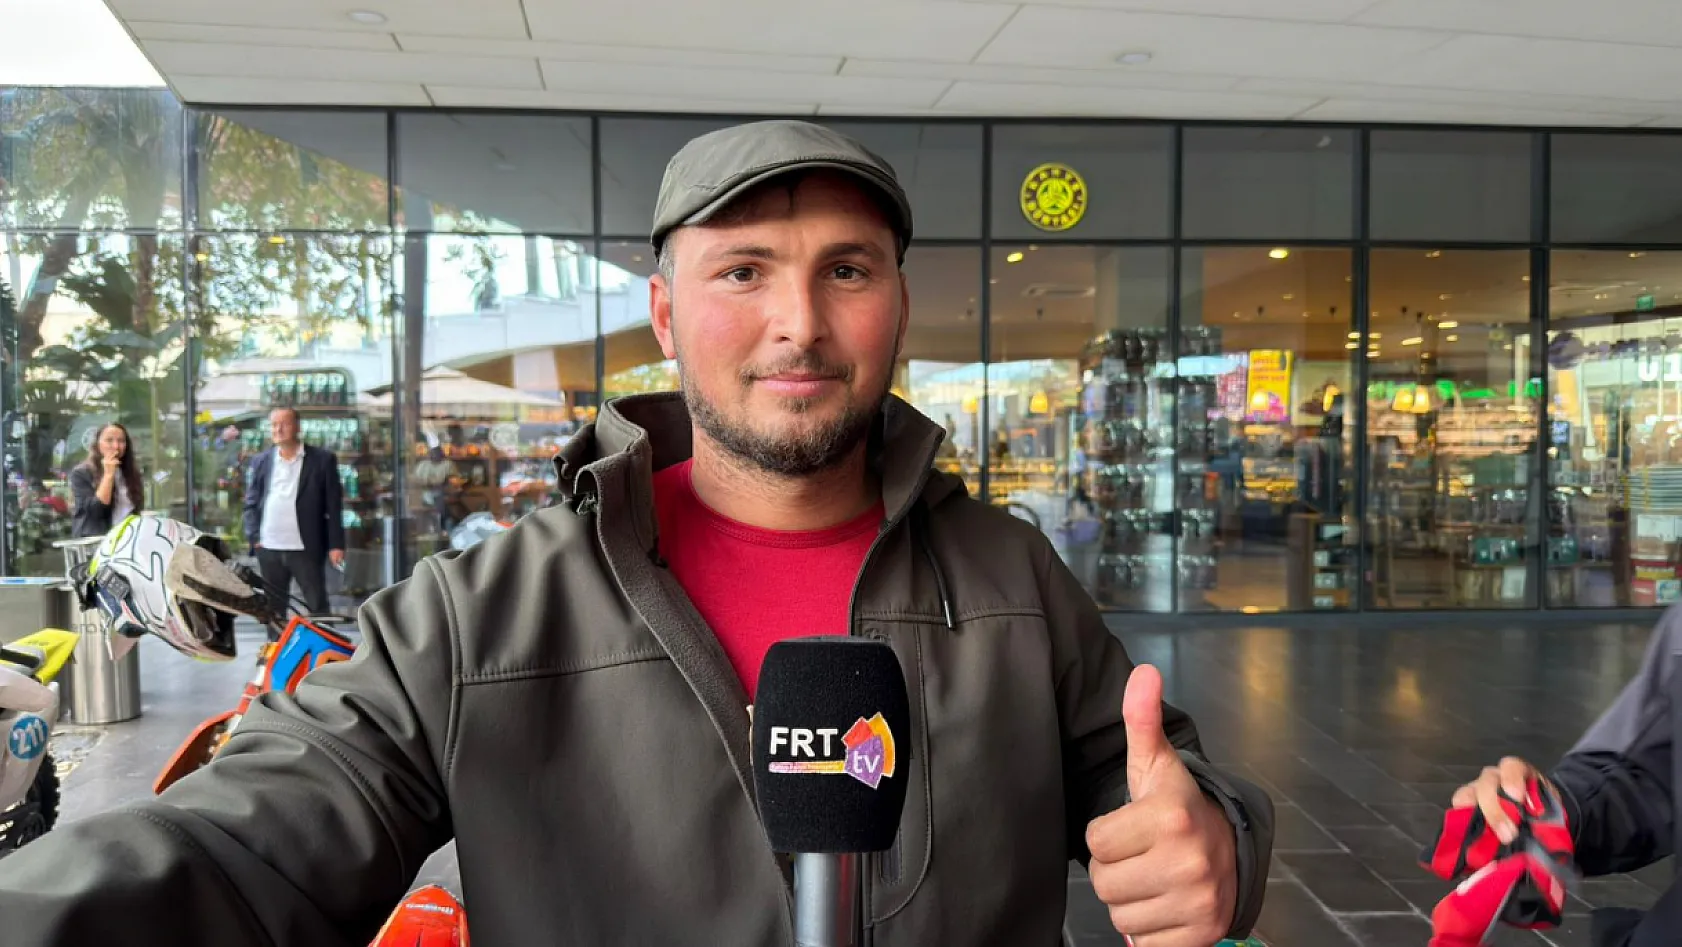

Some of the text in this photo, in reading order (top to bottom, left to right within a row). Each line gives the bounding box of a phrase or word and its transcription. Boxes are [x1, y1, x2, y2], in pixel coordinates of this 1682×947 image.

[12, 718, 43, 755] 211
[769, 726, 839, 757] FRT
[853, 750, 881, 774] tv
